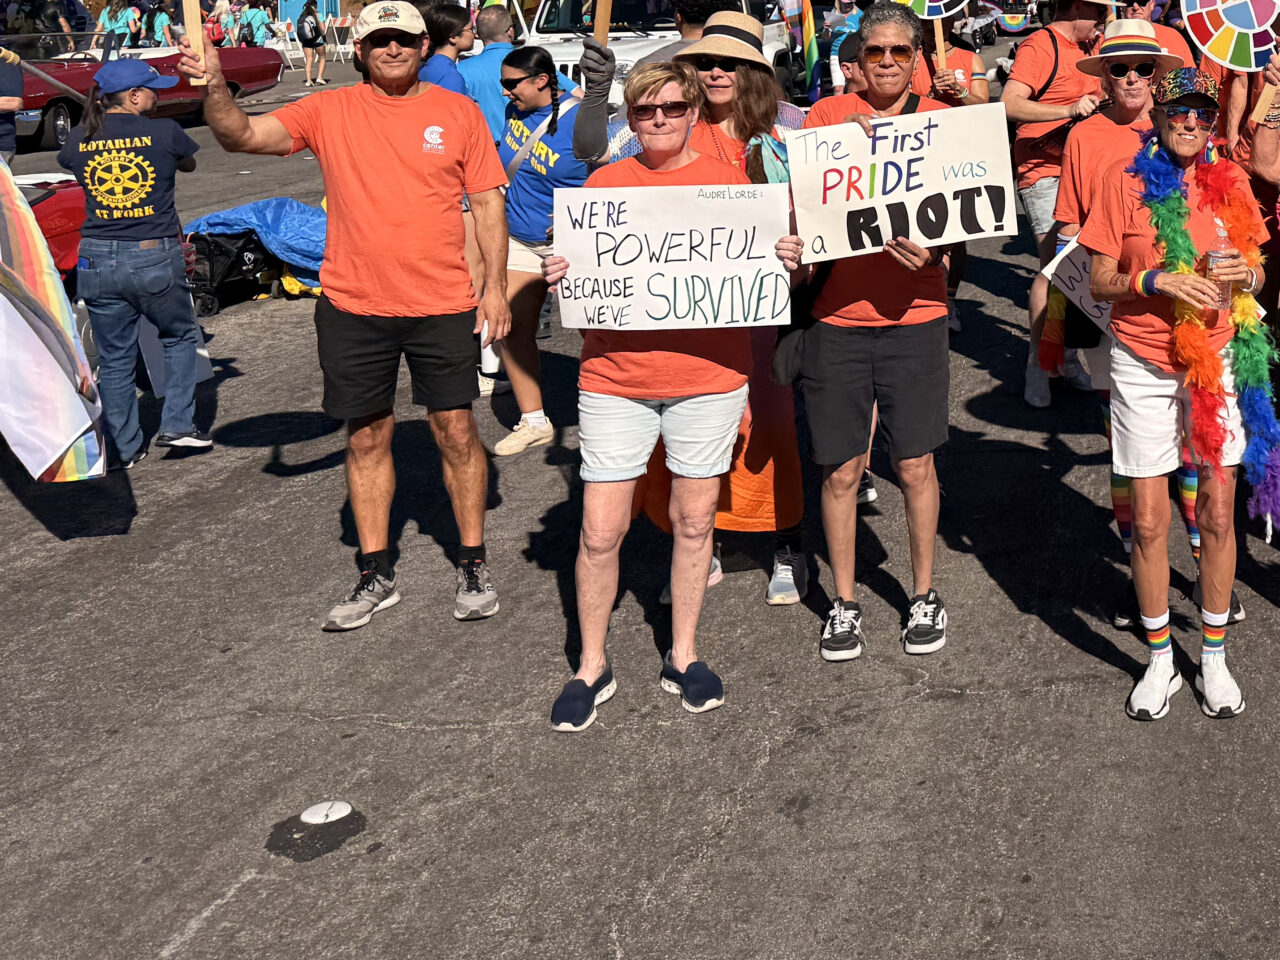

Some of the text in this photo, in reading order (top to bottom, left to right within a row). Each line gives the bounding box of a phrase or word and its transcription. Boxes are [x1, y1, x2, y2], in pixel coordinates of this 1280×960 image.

[796, 117, 939, 164] The First
[697, 188, 727, 200] AUDRE
[822, 157, 988, 205] PRIDE was
[112, 205, 155, 219] WORK
[567, 201, 628, 230] WE'RE
[811, 185, 1006, 254] a RIOT!
[595, 226, 767, 268] POWERFUL
[560, 276, 635, 300] BECAUSE
[583, 268, 791, 327] WE'VE SURVIVED
